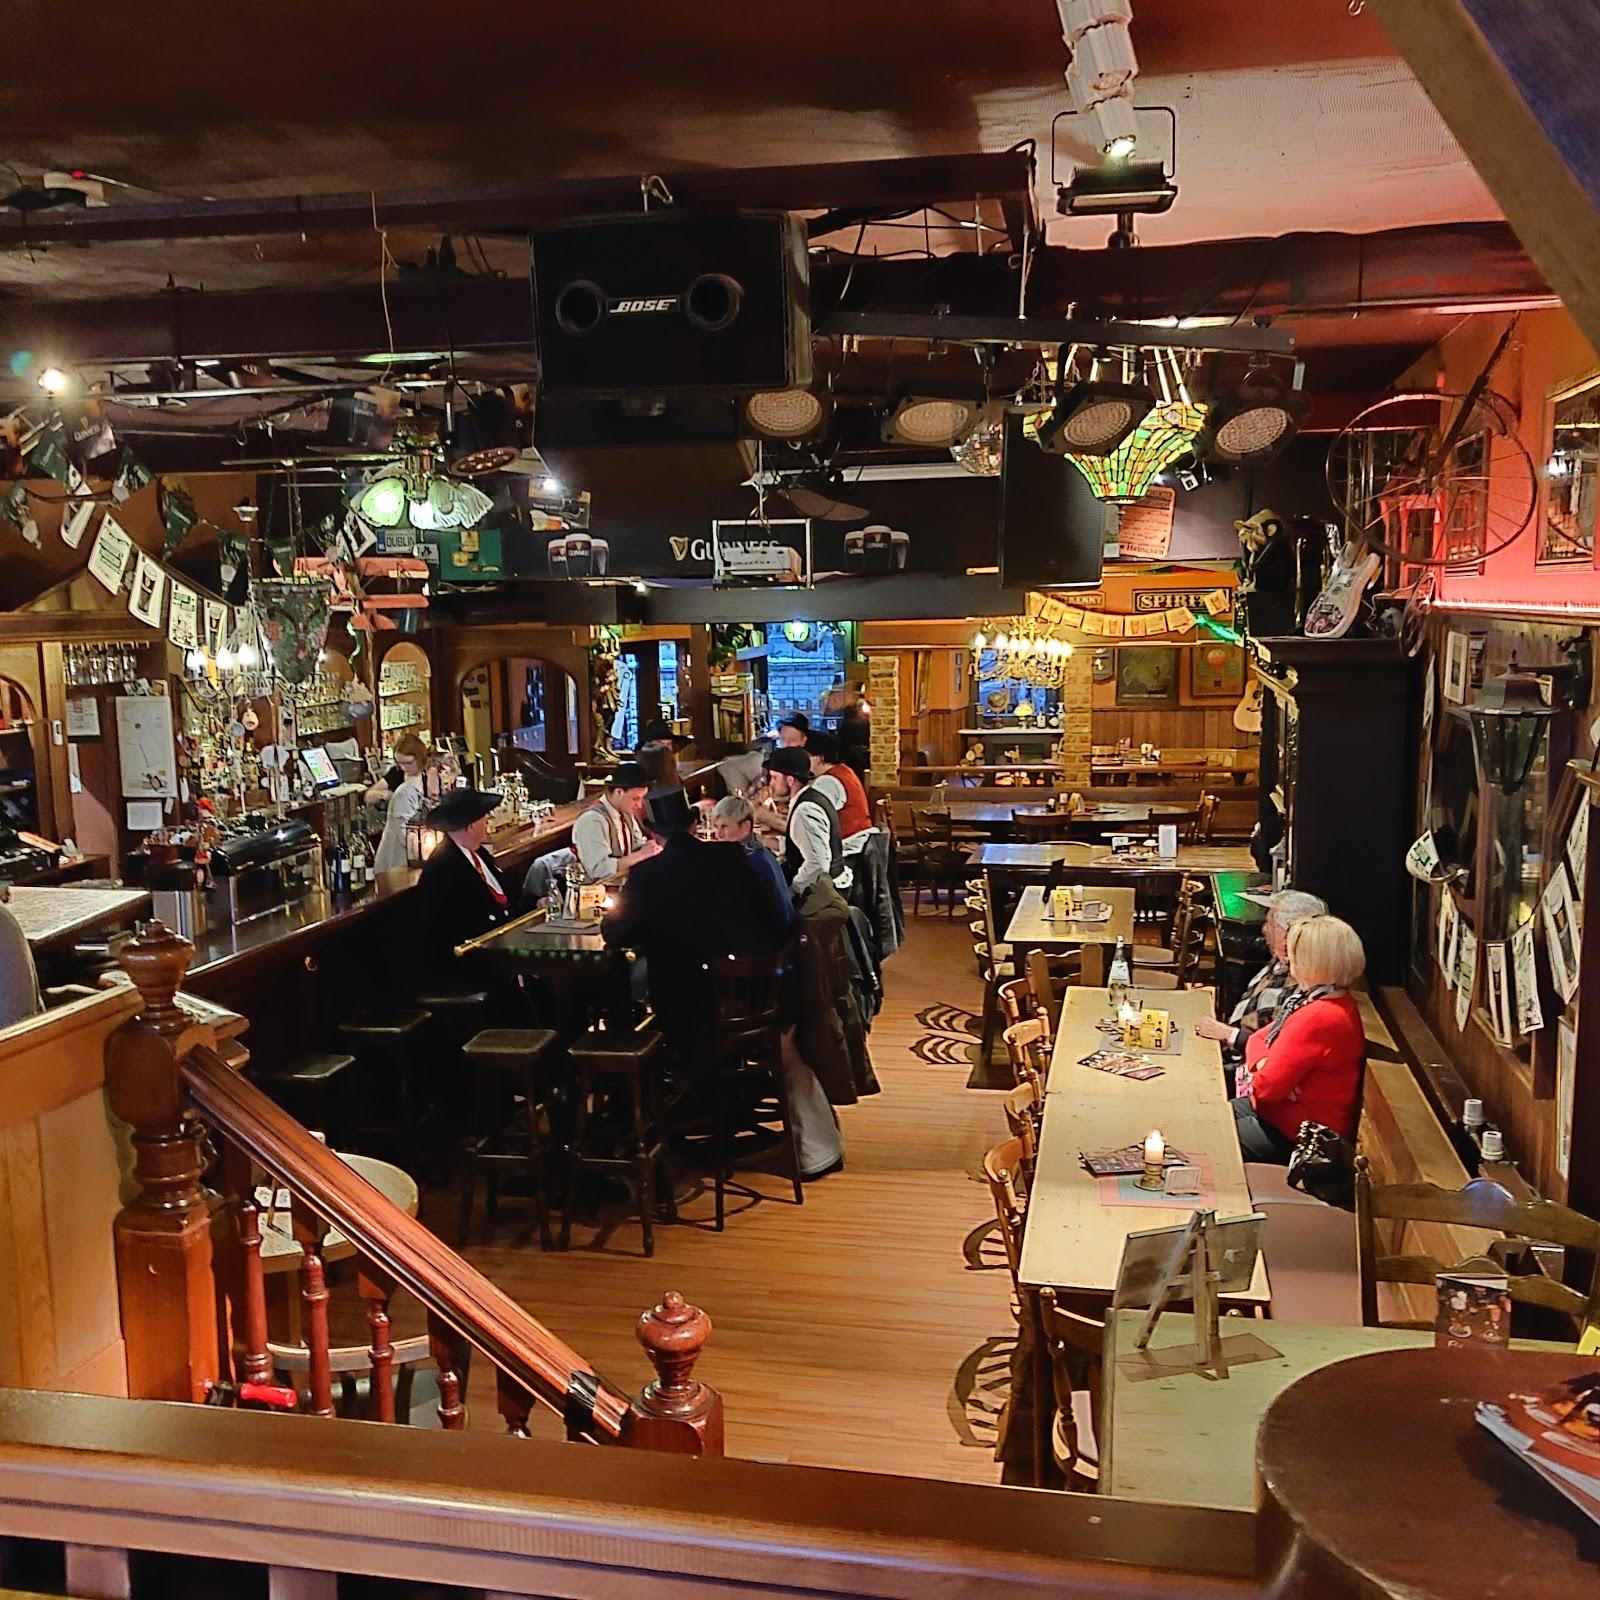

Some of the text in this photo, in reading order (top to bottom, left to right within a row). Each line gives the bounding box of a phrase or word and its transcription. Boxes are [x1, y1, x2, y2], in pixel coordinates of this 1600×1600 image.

[609, 299, 677, 314] BOSE
[386, 536, 416, 548] DUBLIN
[1140, 594, 1206, 608] SPIRIT
